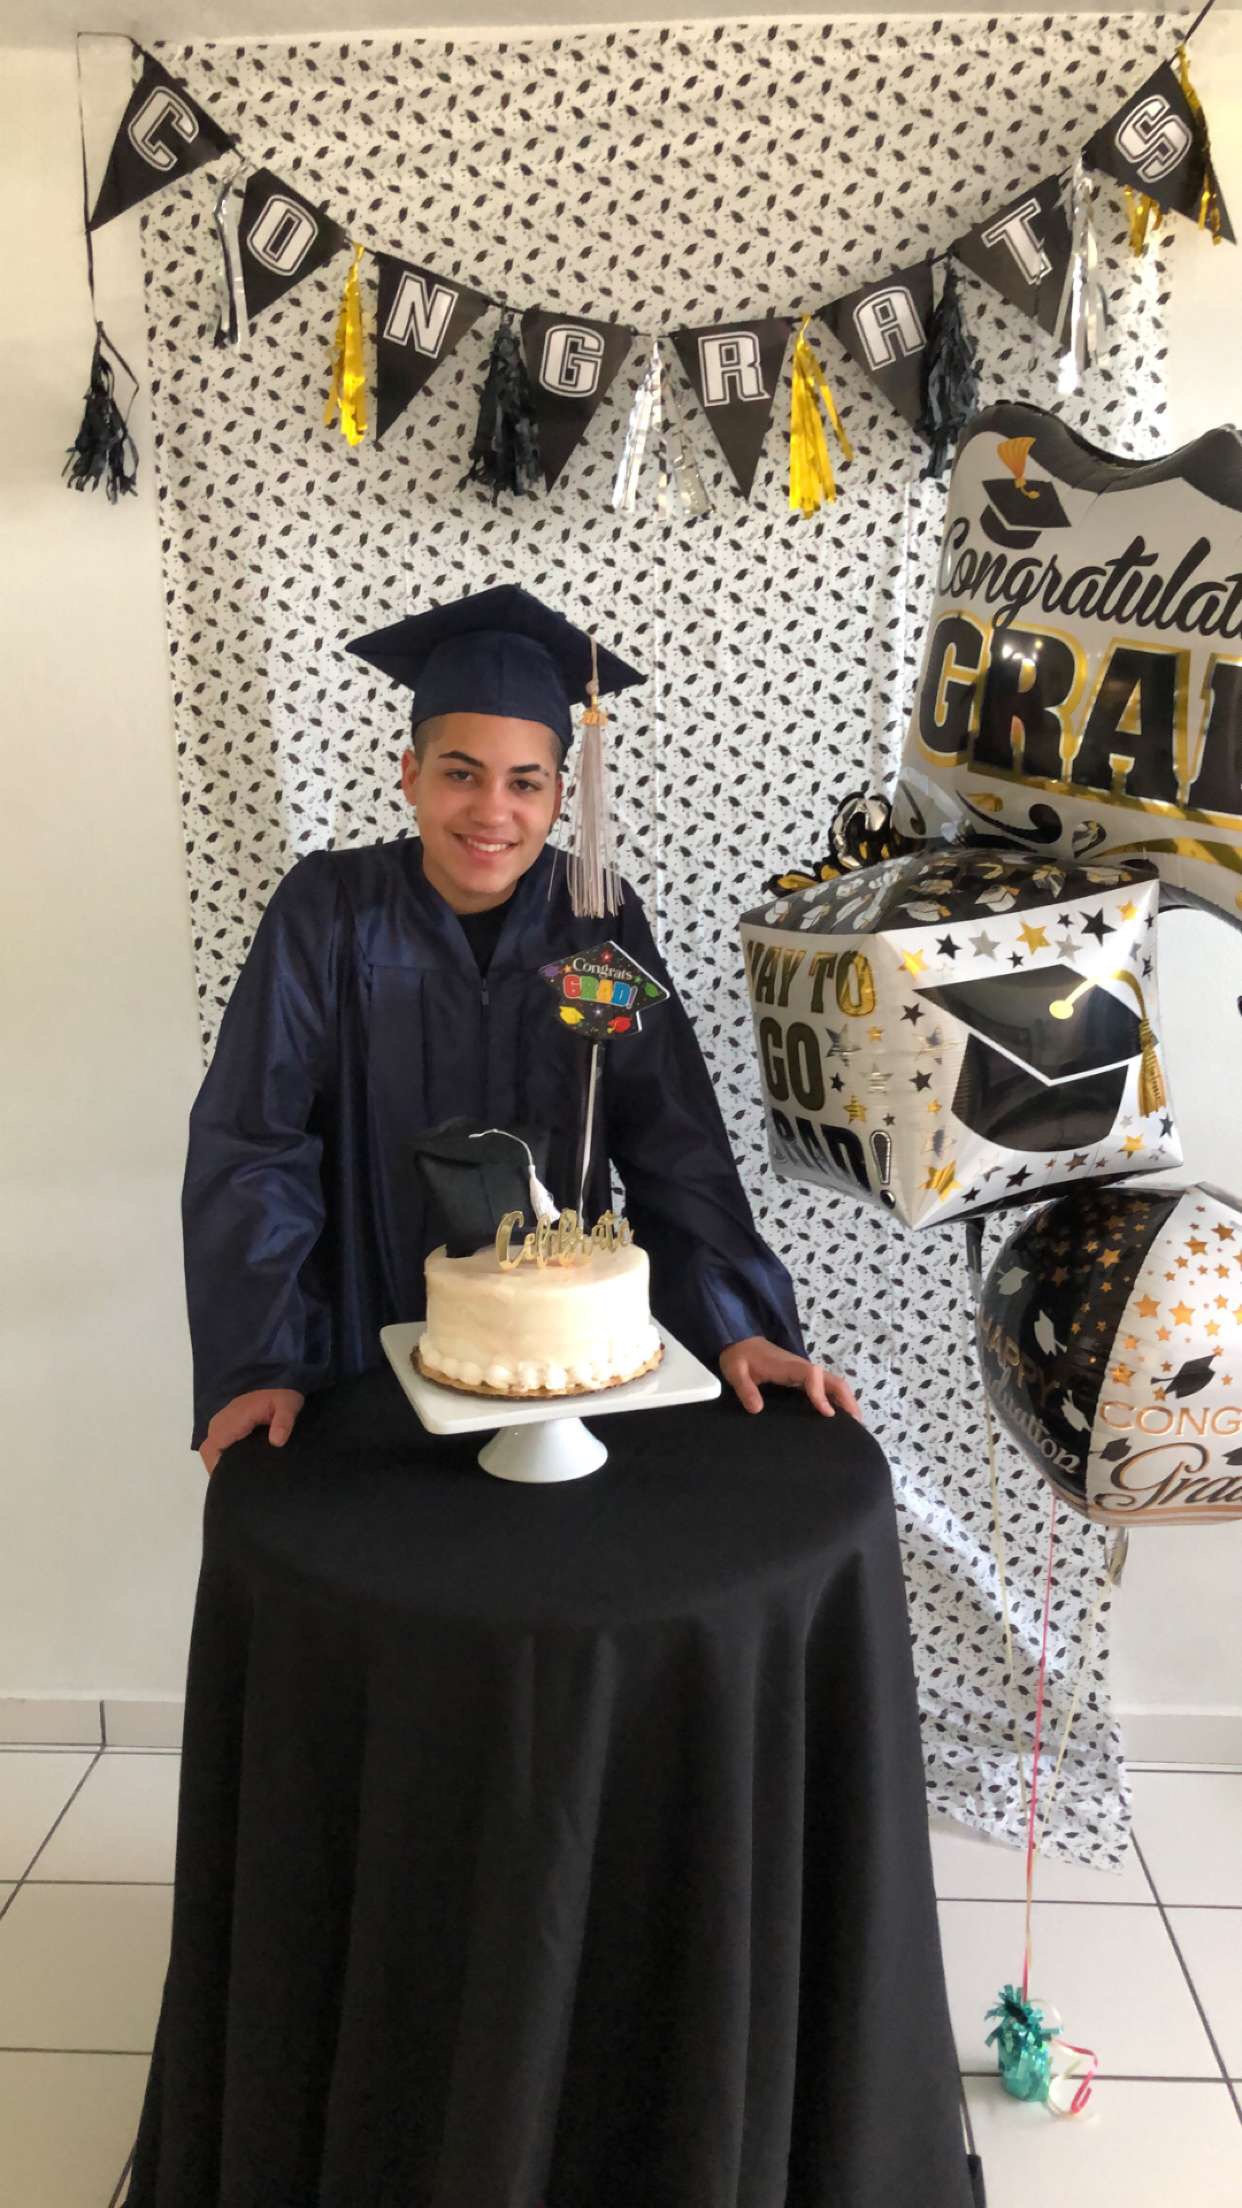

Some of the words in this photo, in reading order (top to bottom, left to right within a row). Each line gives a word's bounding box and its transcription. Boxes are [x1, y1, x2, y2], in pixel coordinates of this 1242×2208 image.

[127, 86, 1192, 407] CONGRATS
[572, 957, 633, 981] Congrats
[808, 950, 876, 1017] TO
[760, 1016, 826, 1111] GO
[1099, 1400, 1242, 1436] CONG
[1093, 1441, 1242, 1512] Gra
